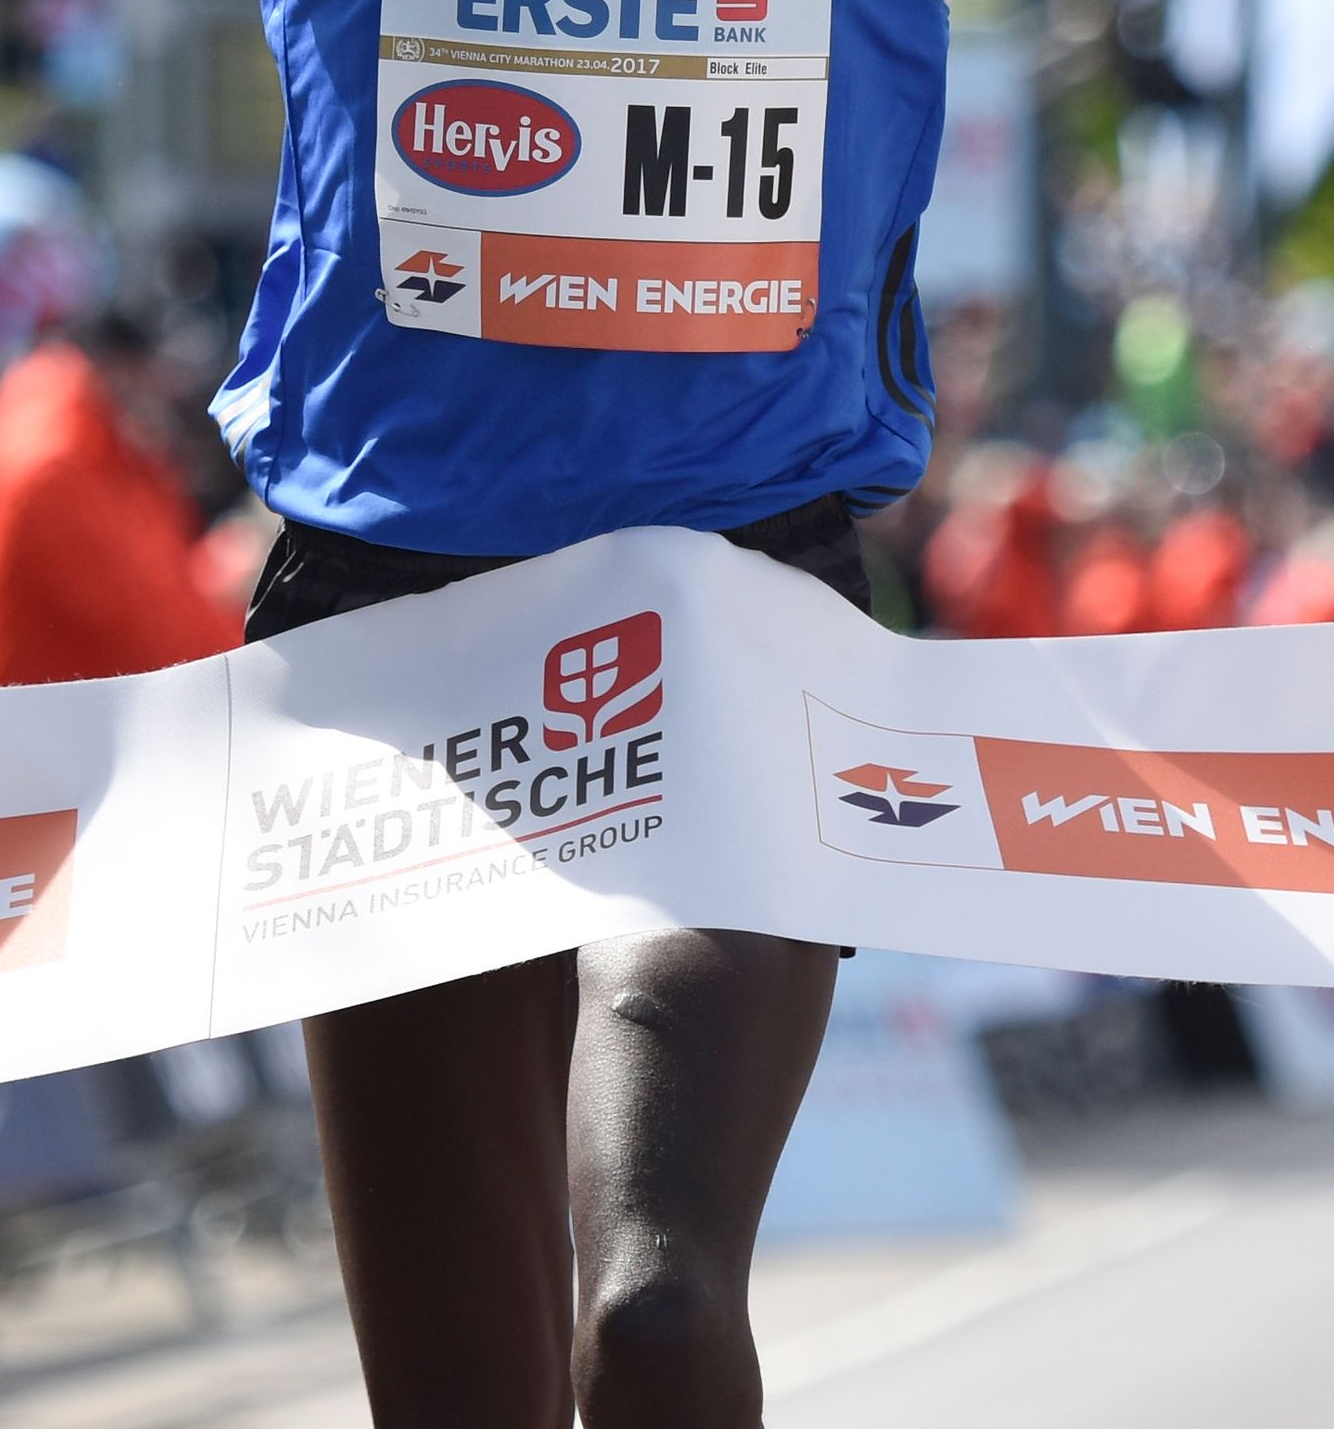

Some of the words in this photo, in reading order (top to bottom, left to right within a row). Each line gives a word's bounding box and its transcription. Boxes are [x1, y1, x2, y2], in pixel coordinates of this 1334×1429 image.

[450, 50, 487, 63] VIENNA
[489, 54, 512, 65] CITY
[513, 56, 574, 69] MARATHON
[714, 27, 766, 43] BANK
[709, 61, 739, 75] Block
[745, 62, 768, 75] Elite
[413, 101, 562, 172] Hervis
[622, 104, 799, 220] M-15
[499, 272, 618, 313] WIEN
[636, 279, 802, 314] ENERGIE
[251, 715, 531, 835] WIENER
[243, 731, 663, 892] STÄDTISCHE
[1020, 791, 1216, 842] WIEN
[243, 899, 359, 944] VIENNA
[369, 847, 549, 914] INSURANCE
[559, 815, 663, 863] GROUP
